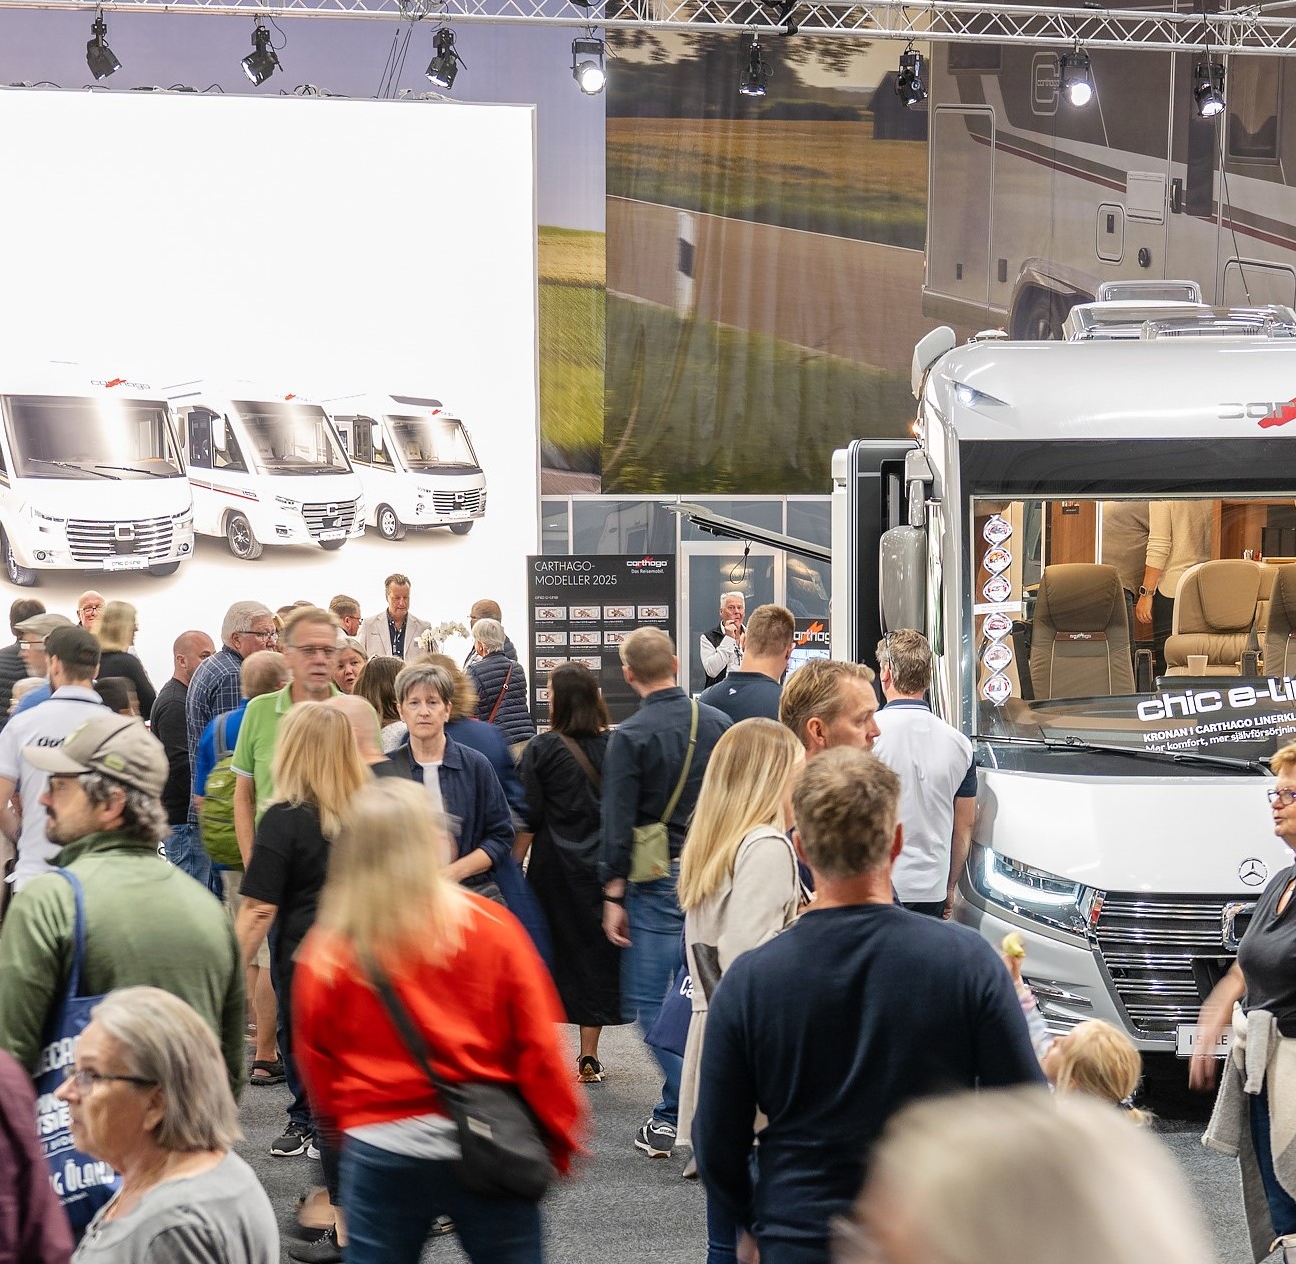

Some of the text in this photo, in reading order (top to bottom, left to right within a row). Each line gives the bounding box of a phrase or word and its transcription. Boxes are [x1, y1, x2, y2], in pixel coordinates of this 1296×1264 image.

[534, 560, 596, 572] CARTHAGO-
[626, 557, 667, 568] carthago
[535, 575, 618, 586] MODELLER 2025
[793, 629, 830, 644] arthag
[1136, 689, 1223, 722] chic
[1143, 728, 1188, 743] KRONAN
[1189, 727, 1194, 736] I
[1195, 718, 1253, 735] CARTHAGO
[1166, 736, 1209, 751] komfort,
[1209, 734, 1230, 744] mer
